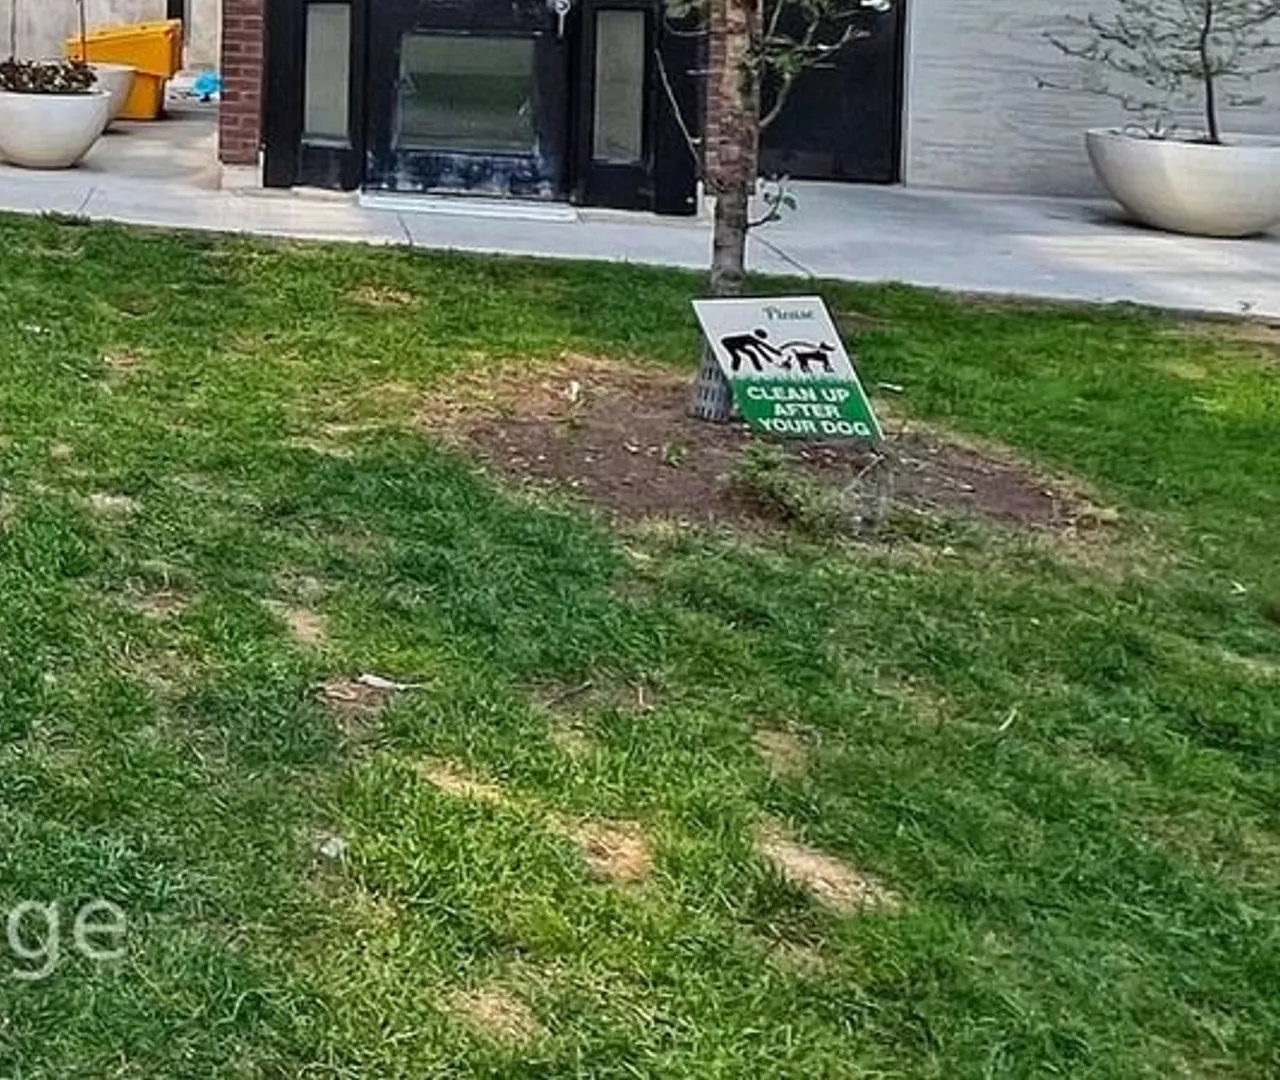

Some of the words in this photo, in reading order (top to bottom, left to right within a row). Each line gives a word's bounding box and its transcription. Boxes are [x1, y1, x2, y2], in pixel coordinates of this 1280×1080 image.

[746, 386, 818, 402] CLEAN
[821, 388, 850, 402] UP
[773, 403, 841, 418] AFTER
[758, 418, 818, 433] YOUR
[820, 420, 871, 436] DOG
